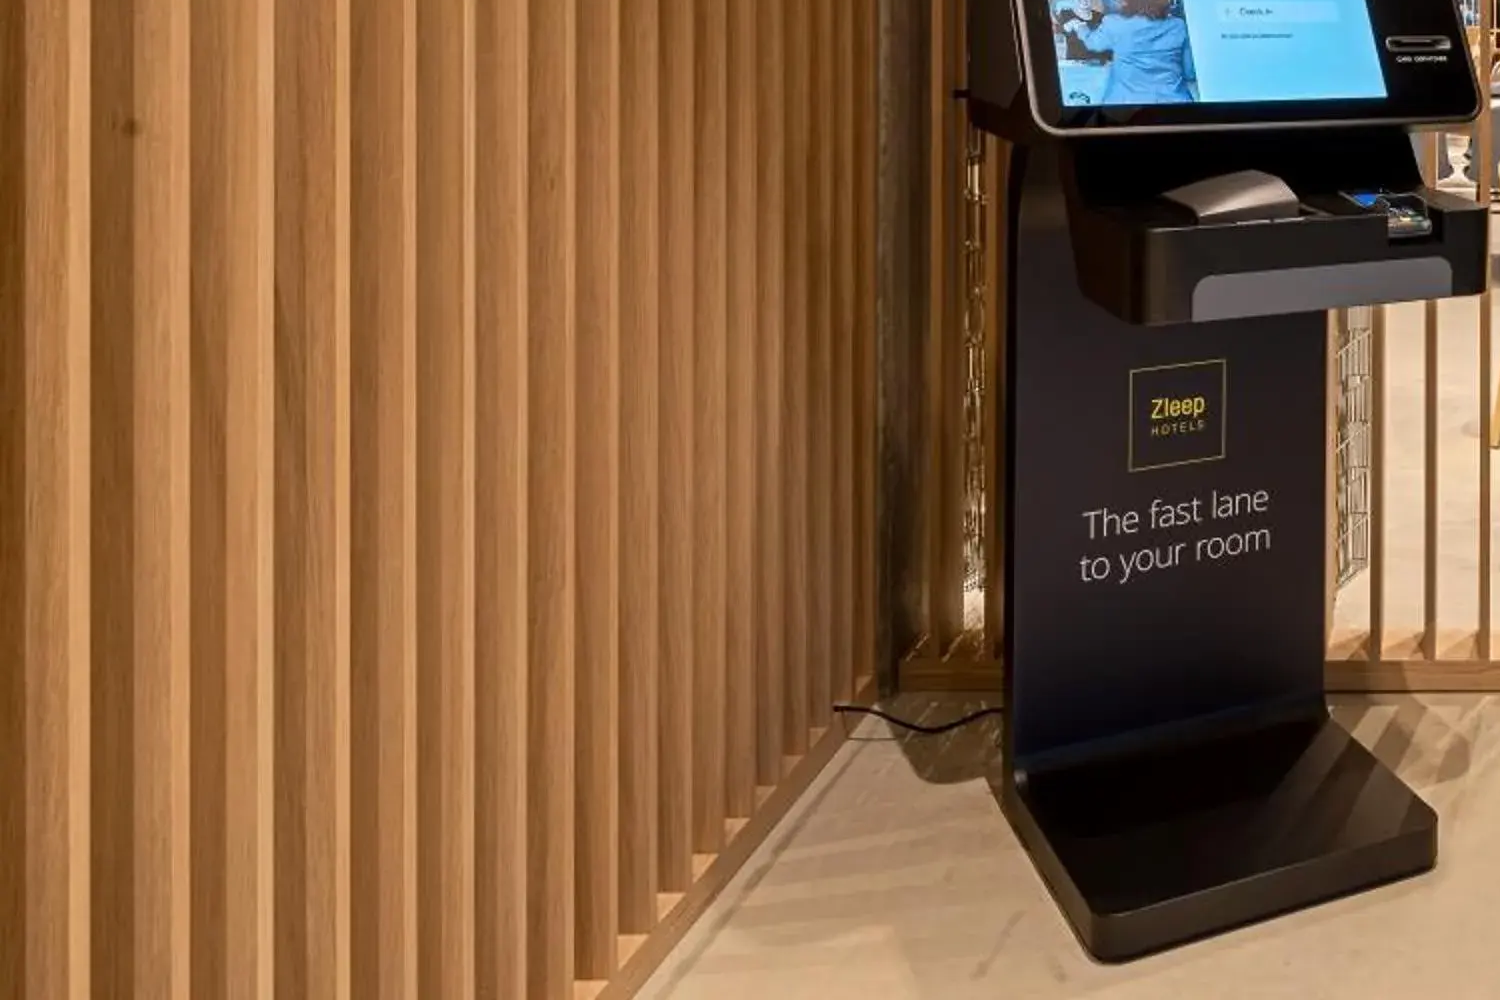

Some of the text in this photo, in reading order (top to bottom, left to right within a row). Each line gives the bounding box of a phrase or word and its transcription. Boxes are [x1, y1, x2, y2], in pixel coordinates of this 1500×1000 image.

[1151, 396, 1206, 419] Zleep
[1150, 419, 1206, 437] HOTELS
[1081, 489, 1269, 540] The fast lane
[1079, 528, 1271, 585] to your room
